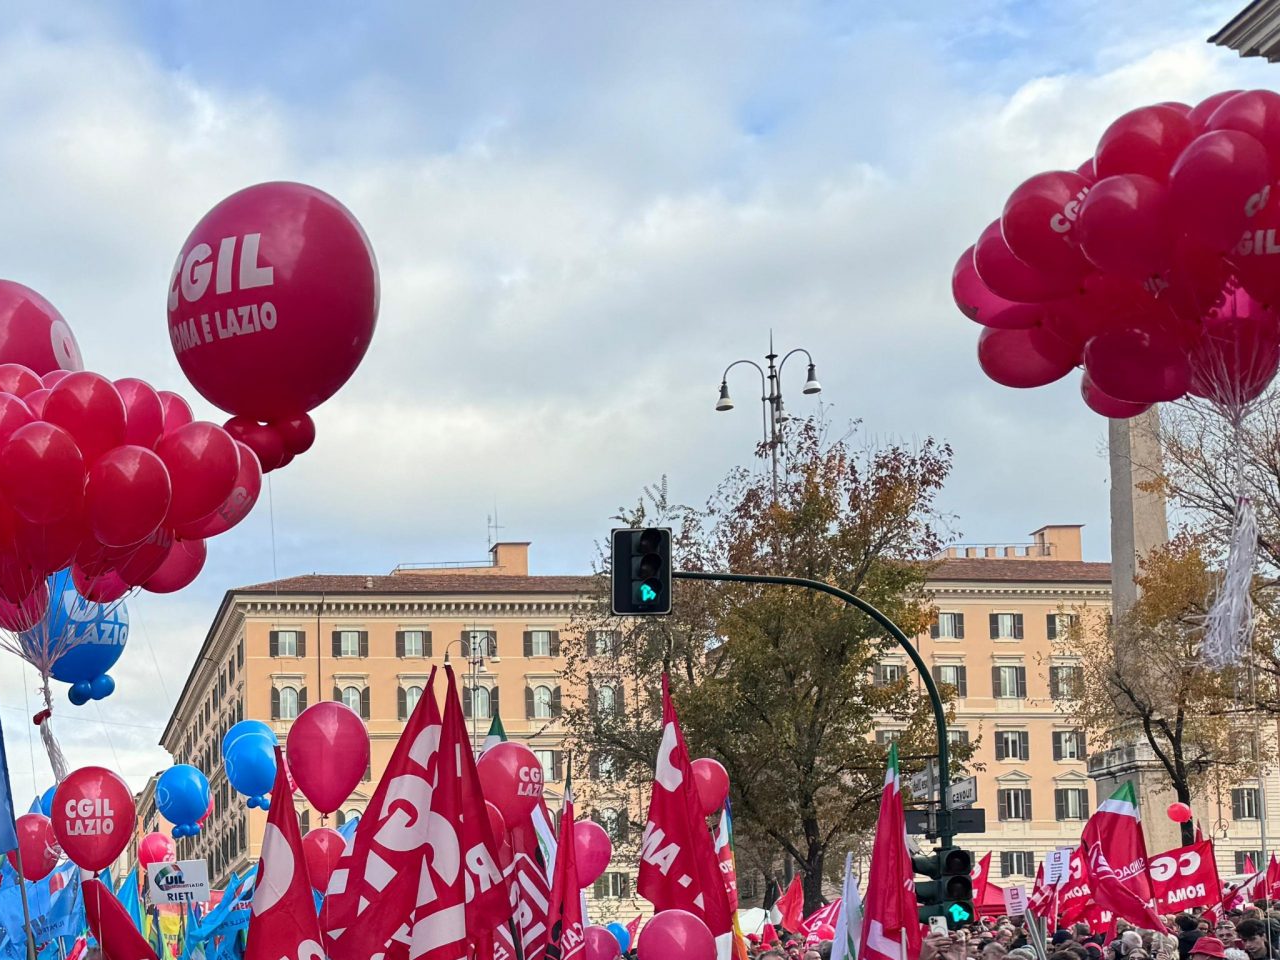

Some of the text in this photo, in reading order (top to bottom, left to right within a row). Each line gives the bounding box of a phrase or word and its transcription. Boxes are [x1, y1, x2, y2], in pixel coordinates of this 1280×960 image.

[201, 314, 213, 343] E
[215, 302, 277, 339] LAZIO
[65, 799, 114, 818] CGIL
[66, 818, 114, 836] LAZIO
[165, 875, 185, 885] UIL
[167, 891, 194, 901] RIETI
